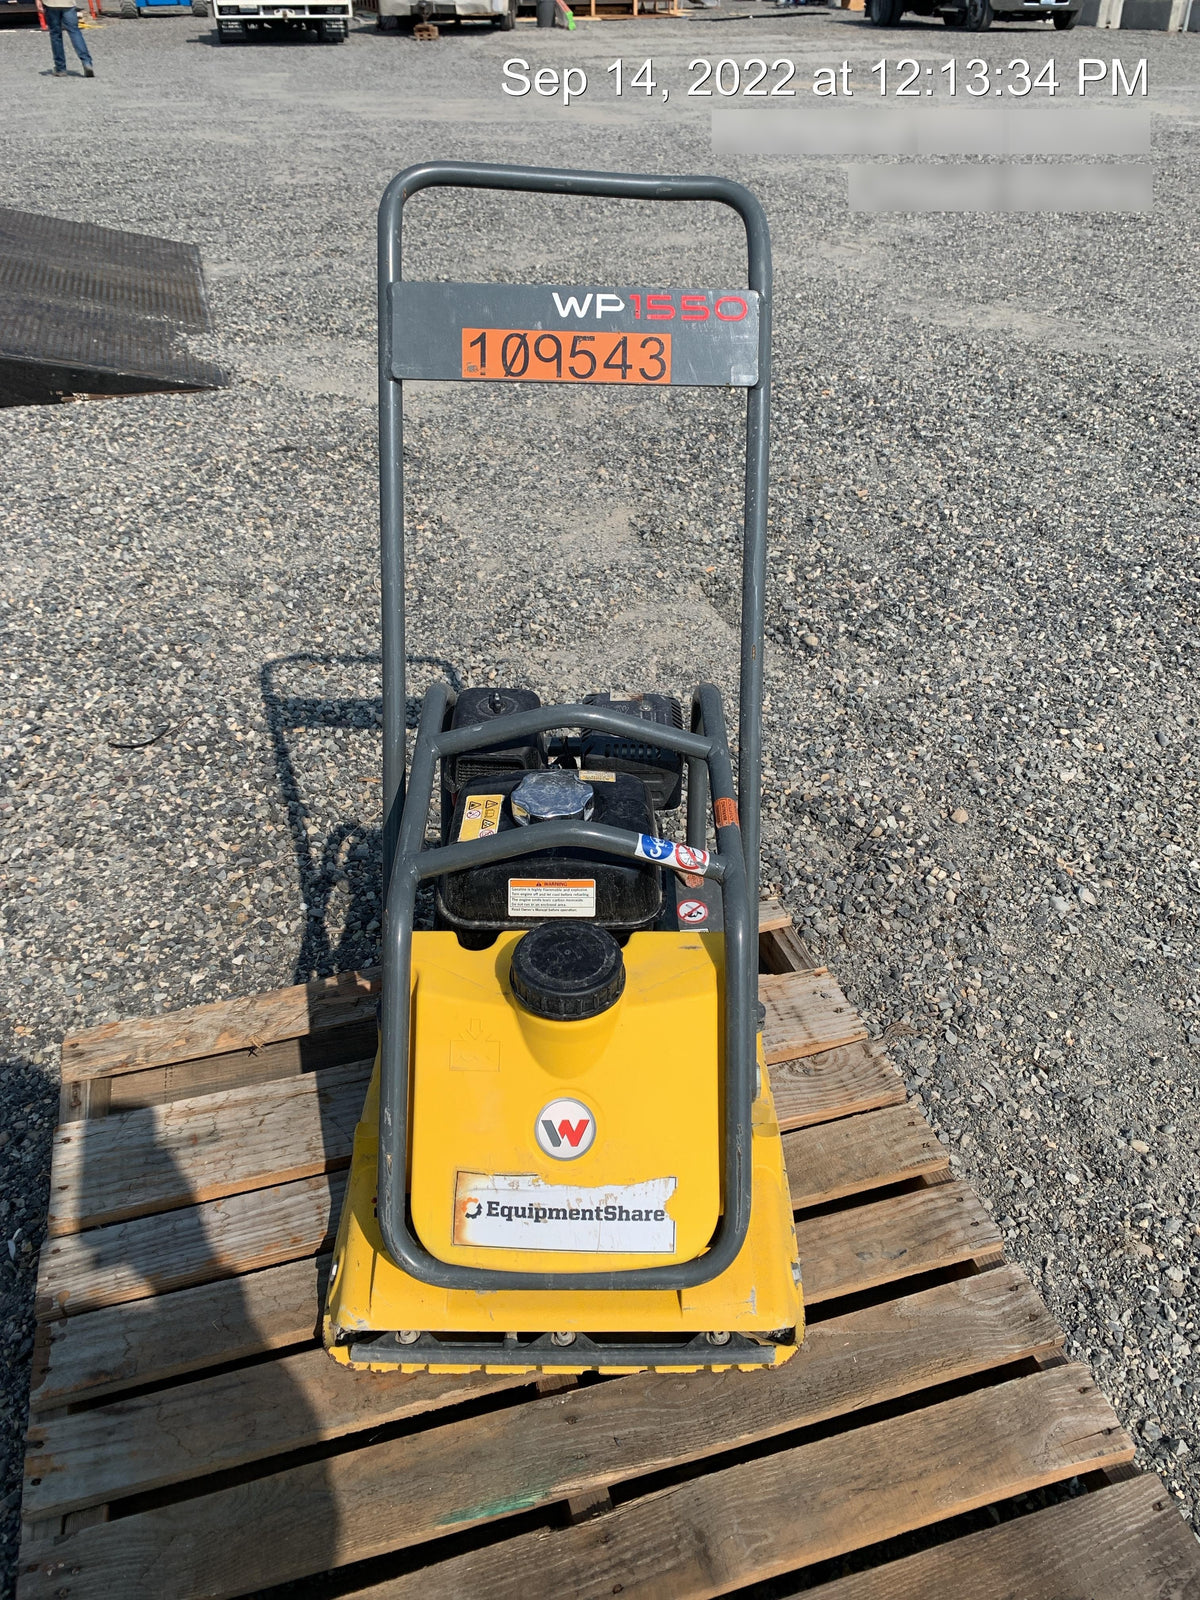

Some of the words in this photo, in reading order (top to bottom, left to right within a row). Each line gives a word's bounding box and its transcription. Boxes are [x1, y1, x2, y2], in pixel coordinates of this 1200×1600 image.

[551, 291, 748, 322] WP1550
[470, 332, 667, 382] 109543
[485, 1200, 666, 1224] EquipmentShare
